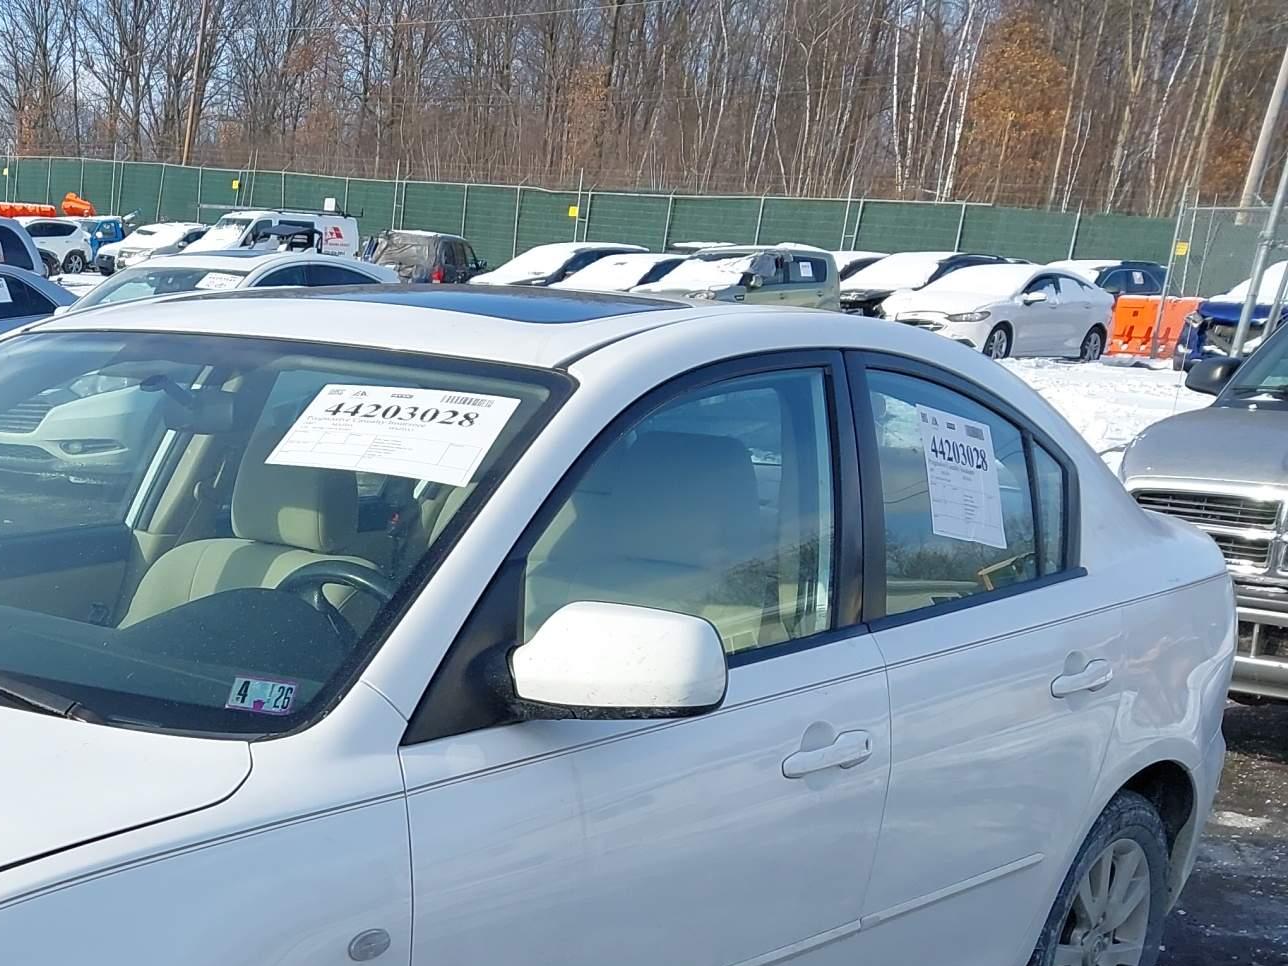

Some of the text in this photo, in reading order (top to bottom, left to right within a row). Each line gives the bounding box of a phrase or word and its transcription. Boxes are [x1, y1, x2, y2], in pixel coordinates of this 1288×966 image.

[325, 402, 480, 428] 44203028
[930, 435, 988, 472] 44203028
[235, 680, 294, 710] 4 26
